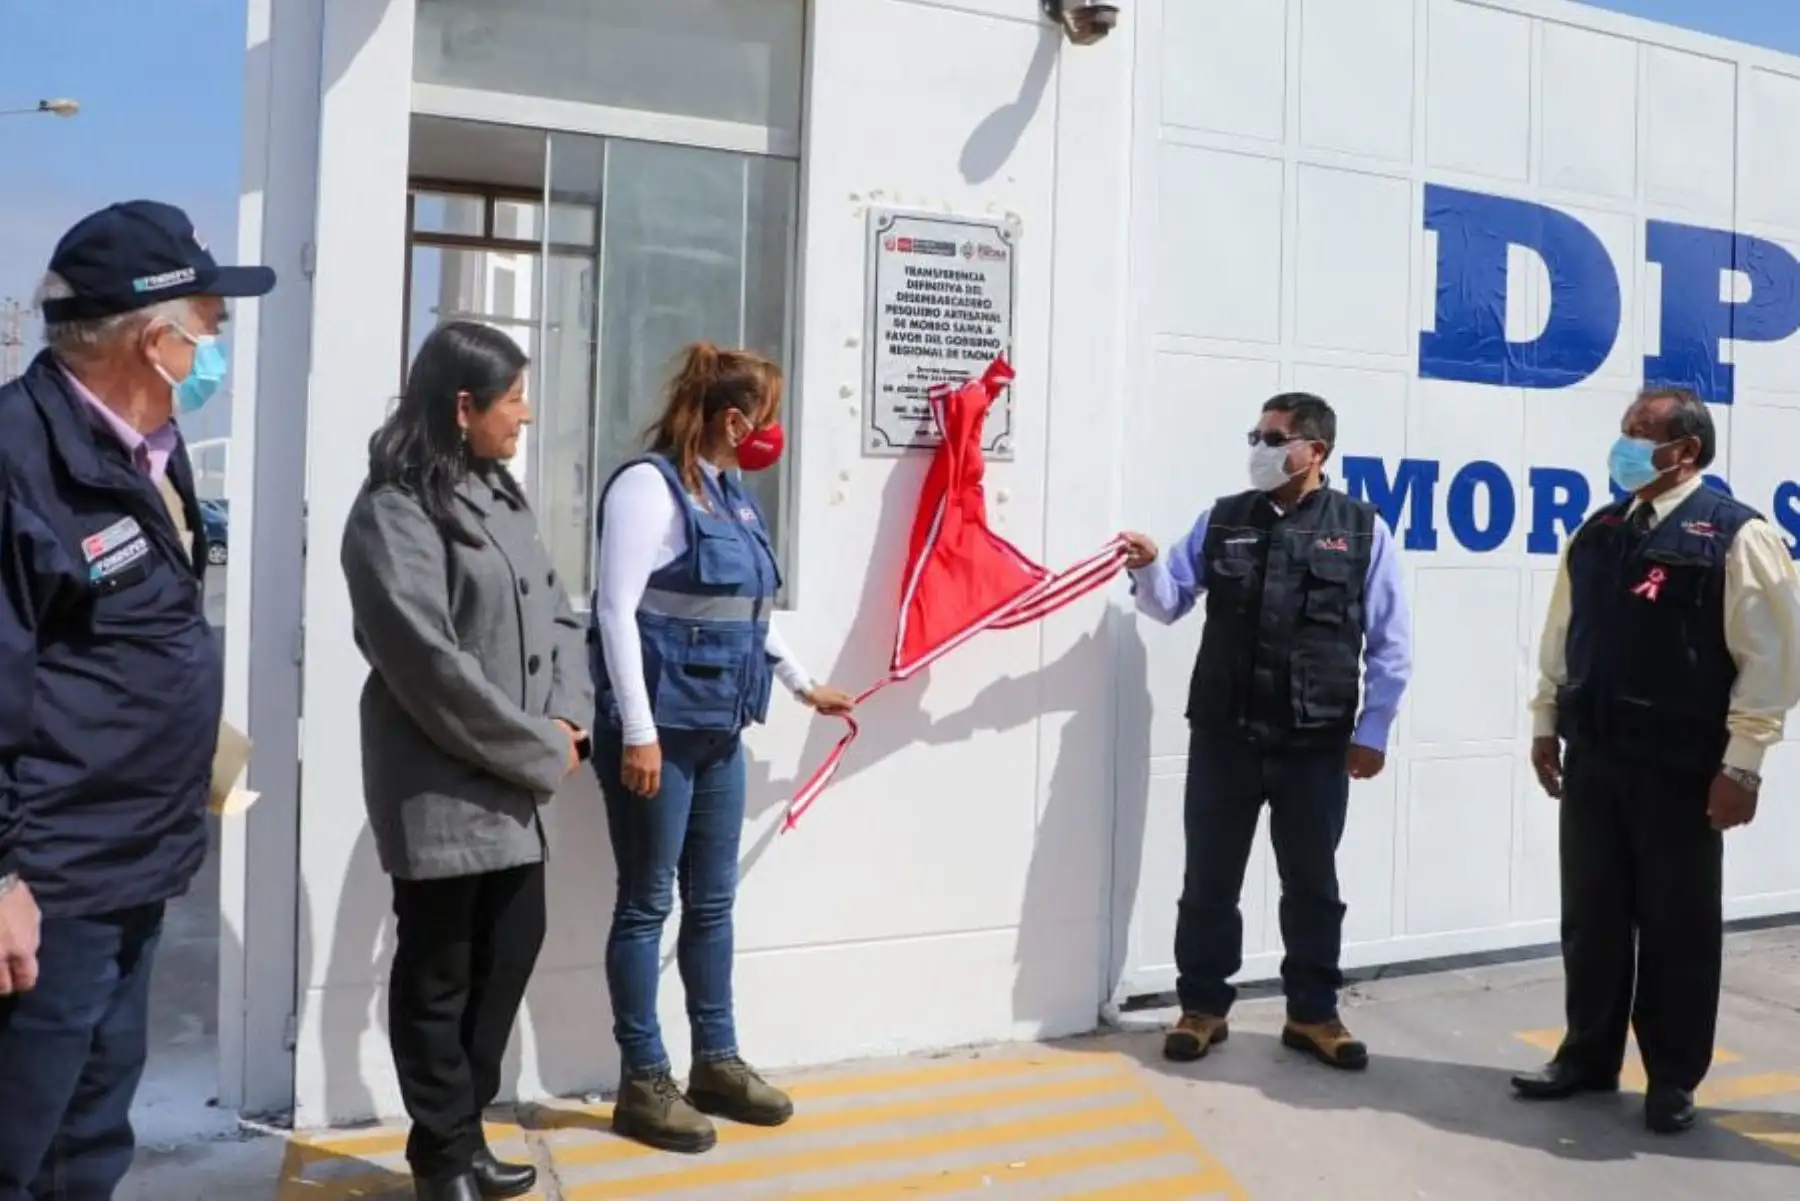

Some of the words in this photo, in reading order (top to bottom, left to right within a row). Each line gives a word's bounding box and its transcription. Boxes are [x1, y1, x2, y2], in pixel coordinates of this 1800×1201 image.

[905, 265, 986, 282] TRANSFERENCIA
[907, 279, 963, 294] DEFINITIVA
[965, 285, 983, 295] DEL
[1419, 182, 1800, 405] DP
[896, 291, 992, 309] DESEMBARCADERO
[885, 304, 941, 318] PESQUERO
[944, 310, 1002, 323] ARTESANAL
[893, 318, 906, 328] DE
[909, 319, 951, 331] MORRO
[953, 323, 983, 334] SAMA
[985, 327, 994, 335] A
[885, 331, 923, 343] FAVOR
[925, 333, 943, 344] DEL
[945, 336, 1001, 349] GOBIERNO
[889, 344, 943, 359] REGIONAL
[946, 349, 959, 359] DE
[962, 350, 995, 361] TACNA
[1342, 456, 1733, 555] MOR
